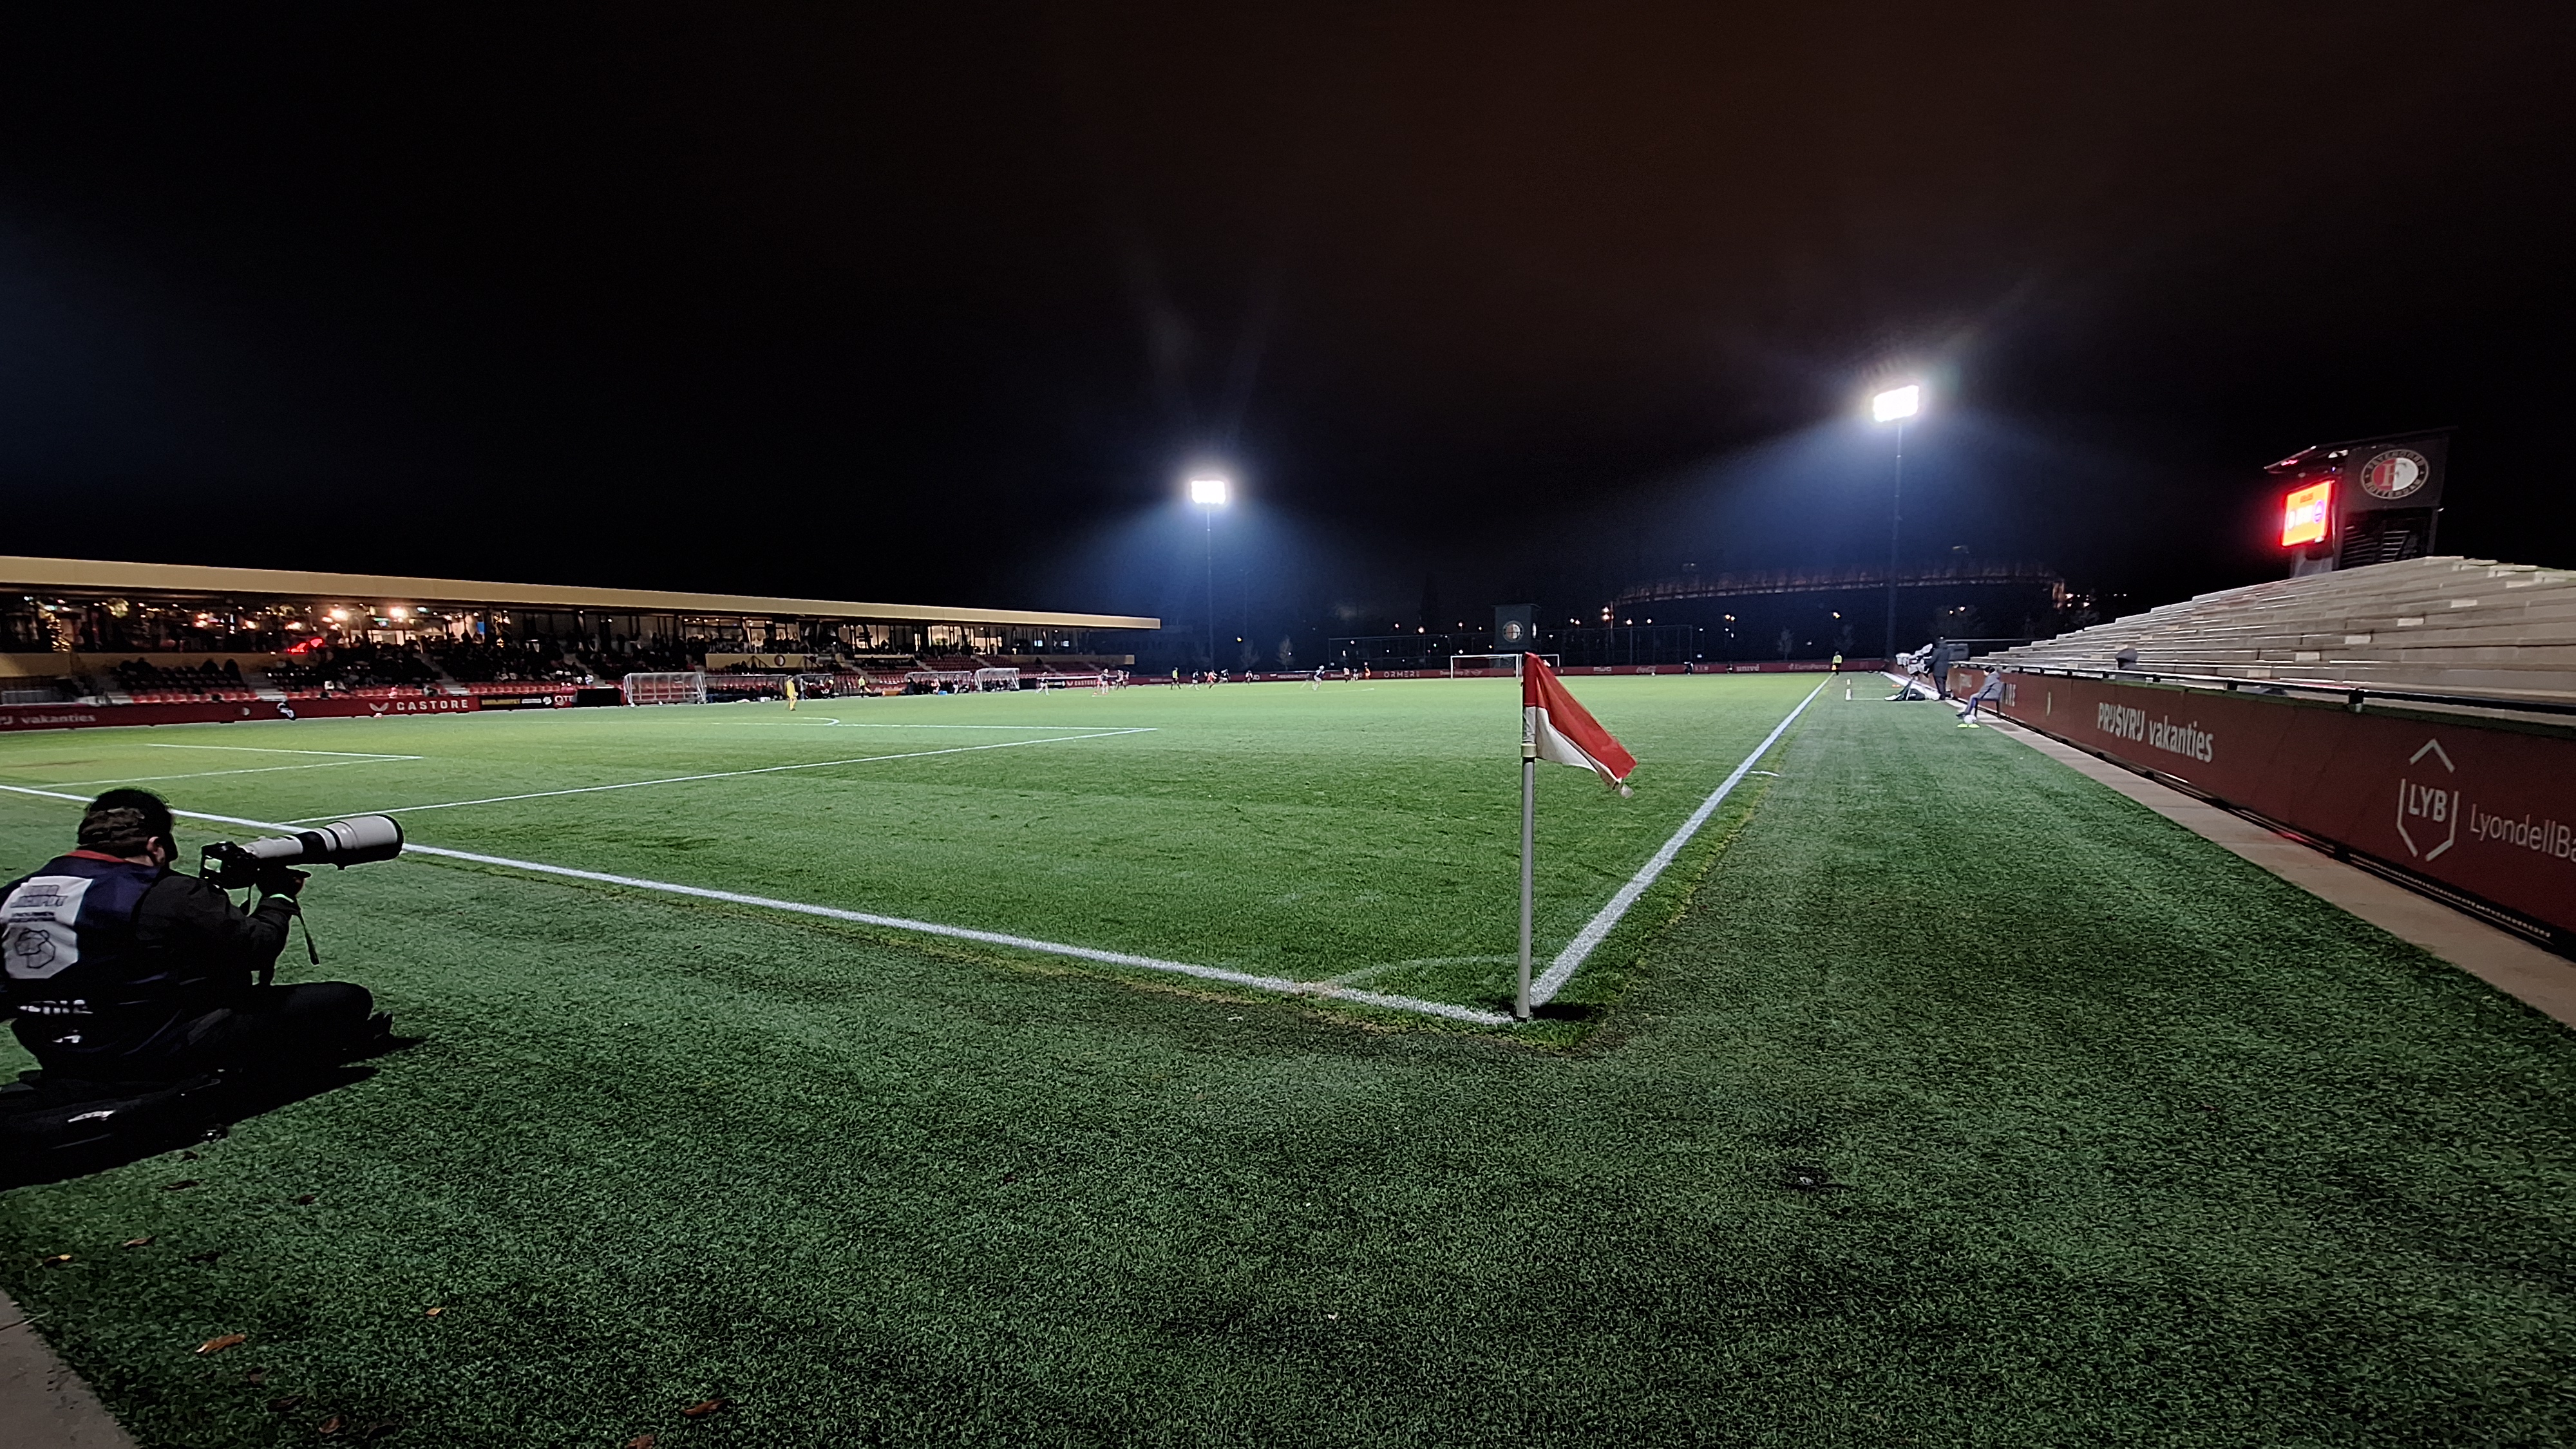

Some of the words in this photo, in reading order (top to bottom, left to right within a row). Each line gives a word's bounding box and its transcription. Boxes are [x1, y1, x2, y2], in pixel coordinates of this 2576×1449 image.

[396, 699, 469, 711] CASTORE
[21, 714, 97, 724] vakanties
[2148, 715, 2214, 763] vakanties
[2408, 783, 2448, 822] LYB
